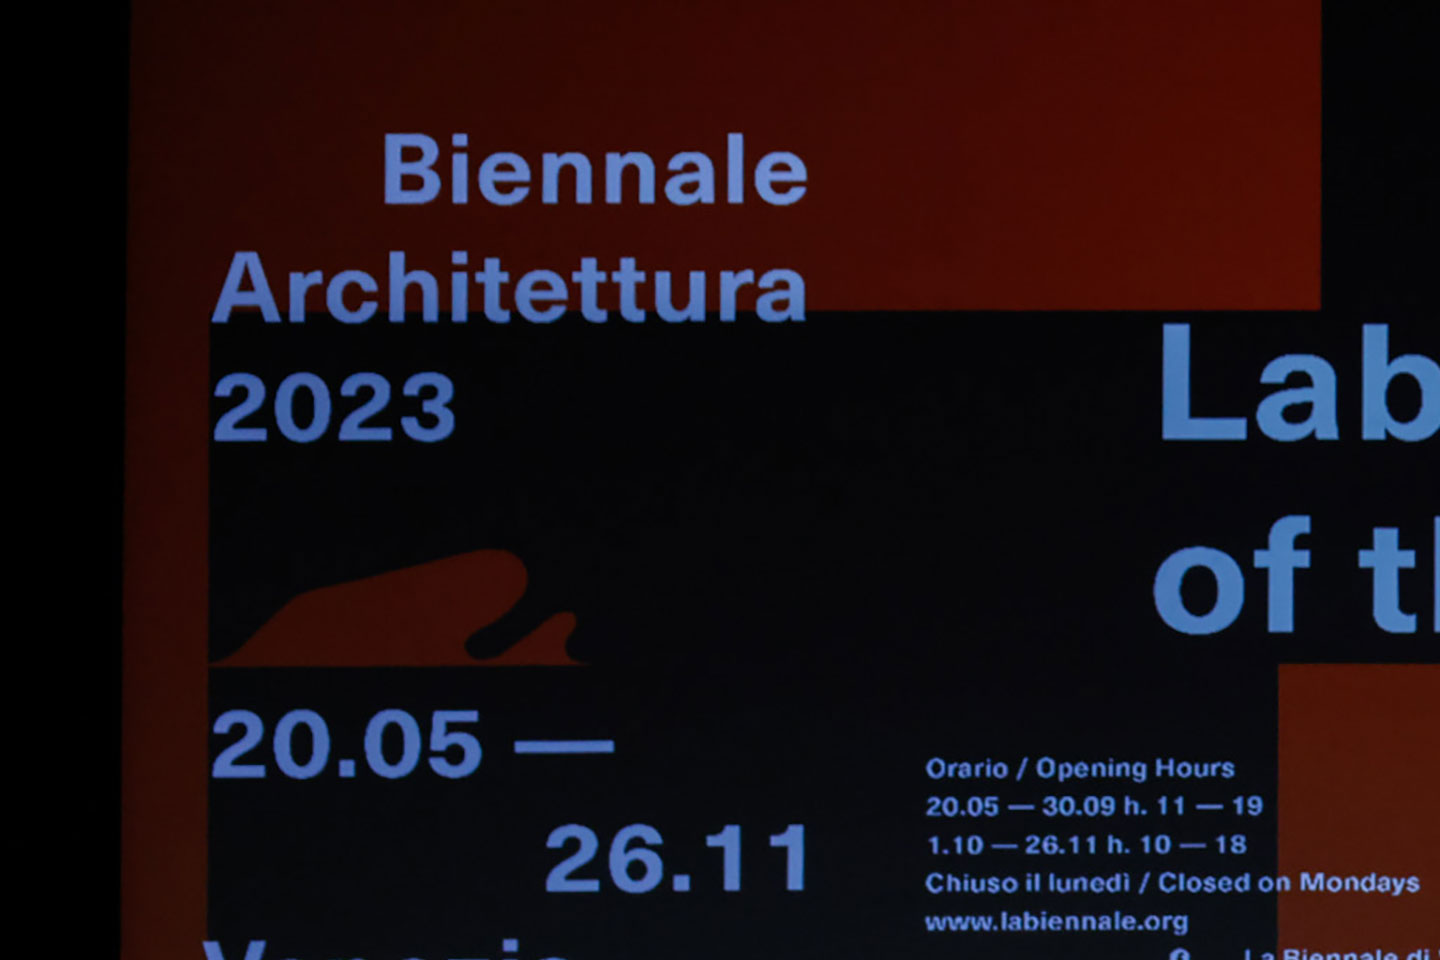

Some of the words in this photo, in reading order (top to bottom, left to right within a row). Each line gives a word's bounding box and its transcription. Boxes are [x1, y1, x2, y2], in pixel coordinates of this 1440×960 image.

[385, 133, 807, 205] Biennale
[212, 251, 805, 323] Architettura
[215, 372, 454, 442] 2023
[1154, 515, 1310, 634] of
[213, 710, 482, 779] 20.05
[926, 757, 1008, 779] Orario
[1017, 757, 1028, 780] /
[1036, 757, 1147, 783] Opening
[1156, 758, 1235, 778] Hours
[926, 796, 999, 817] 20.05
[1043, 796, 1116, 816] 30.09
[1125, 796, 1147, 815] h.
[1158, 796, 1183, 815] 11
[1233, 796, 1263, 816] 19
[546, 824, 804, 893] 26.11
[929, 835, 984, 855] 1.10
[1026, 835, 1096, 854] 26.11
[1108, 835, 1130, 853] h.
[1141, 835, 1172, 854] 10
[1216, 834, 1247, 854] 18
[925, 872, 1019, 894] Chiuso
[1026, 873, 1040, 891] il
[1049, 872, 1130, 893] lunedì
[1139, 872, 1150, 894] /
[1159, 872, 1250, 893] Closed
[1258, 876, 1291, 893] on
[1300, 872, 1420, 896] Mondays
[925, 911, 1188, 936] www.labiennale.org
